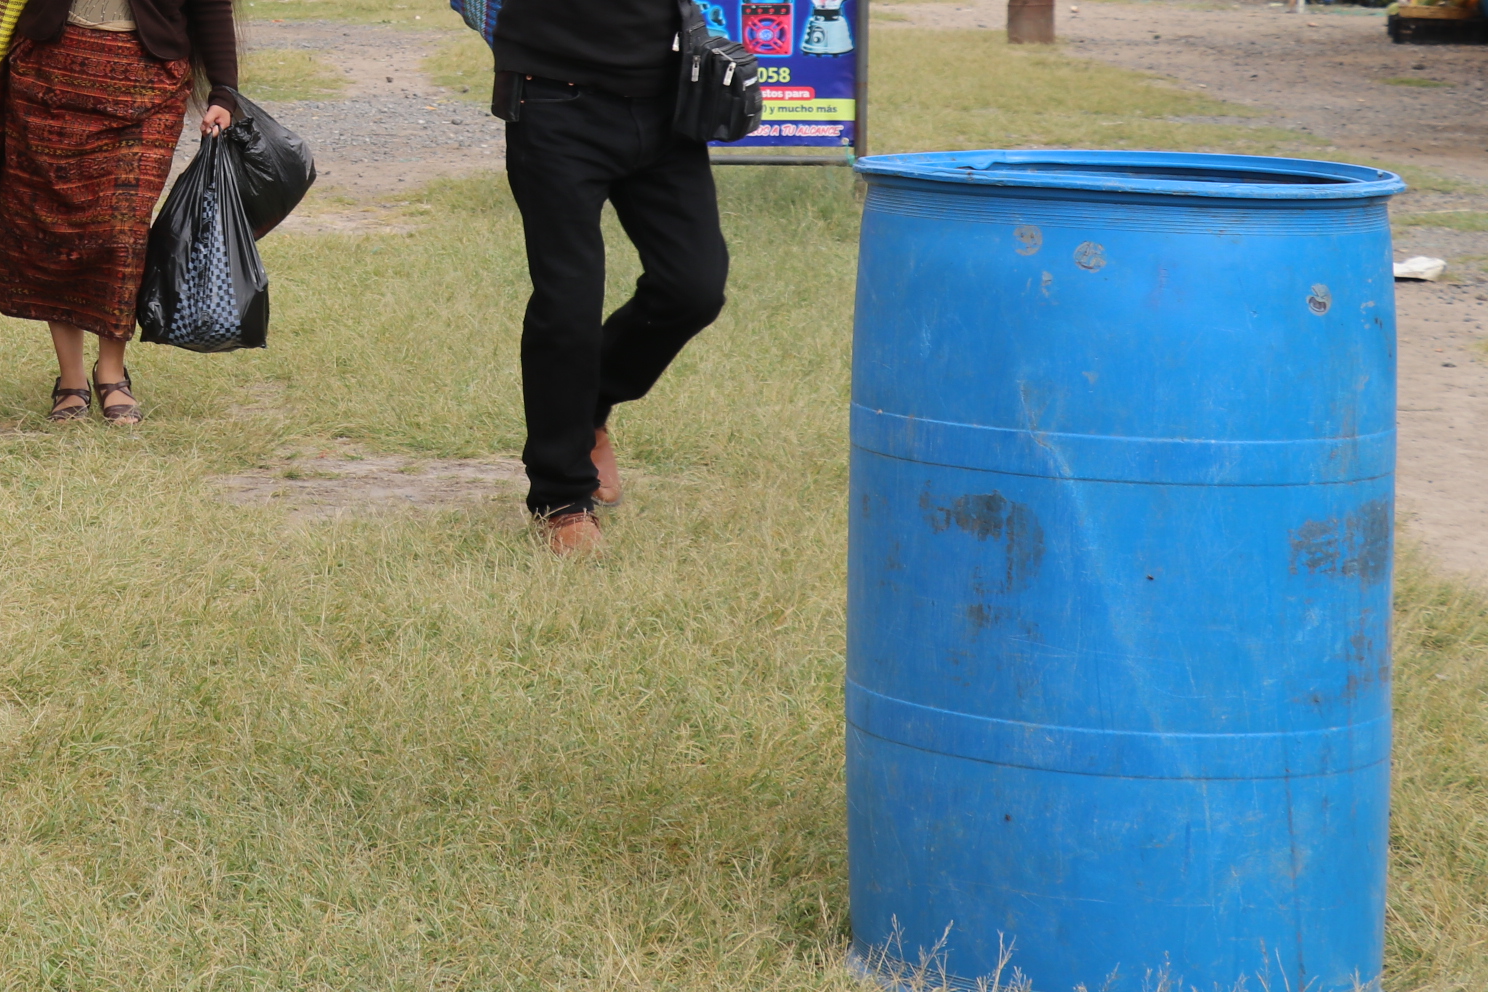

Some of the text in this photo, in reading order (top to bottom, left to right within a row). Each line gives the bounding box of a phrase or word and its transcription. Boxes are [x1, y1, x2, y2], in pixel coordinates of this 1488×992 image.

[785, 89, 811, 100] para
[769, 104, 838, 115] y mucho más
[770, 125, 780, 137] A
[780, 123, 797, 137] TU
